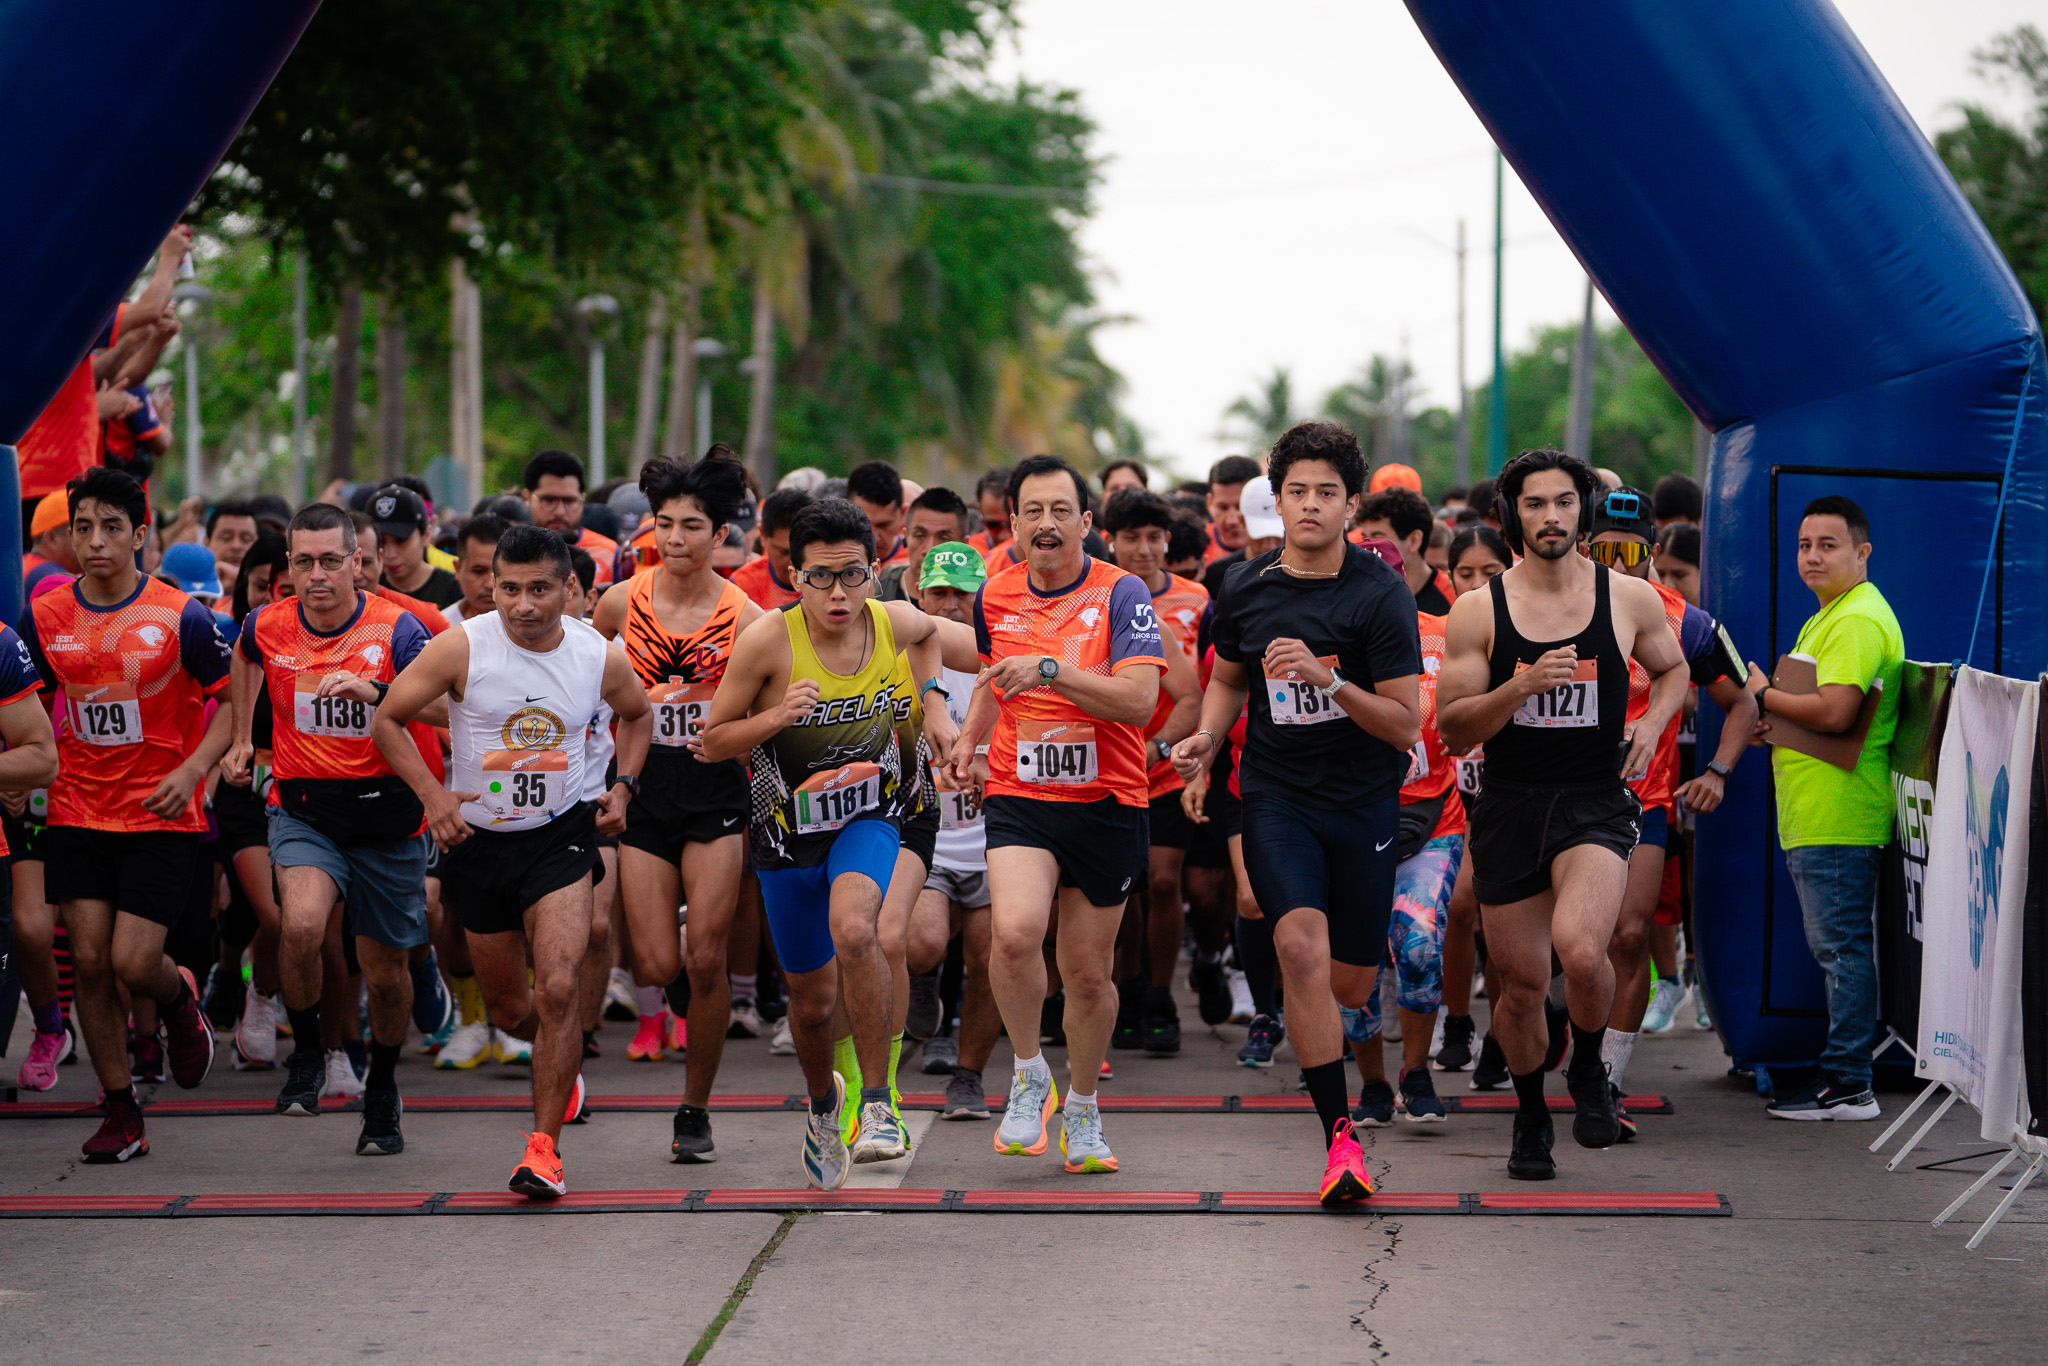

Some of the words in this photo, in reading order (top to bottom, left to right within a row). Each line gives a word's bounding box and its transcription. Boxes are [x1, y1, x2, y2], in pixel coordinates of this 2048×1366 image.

[1003, 615, 1019, 623] IEST
[56, 635, 74, 643] IEST
[1131, 632, 1150, 640] AÑOS
[275, 654, 296, 664] IEST
[311, 697, 366, 729] 1138
[1537, 683, 1586, 717] 1127
[84, 703, 126, 735] 129
[661, 703, 702, 737] 313
[1034, 744, 1087, 778] 1047
[513, 773, 546, 807] 35
[816, 781, 869, 821] 1181
